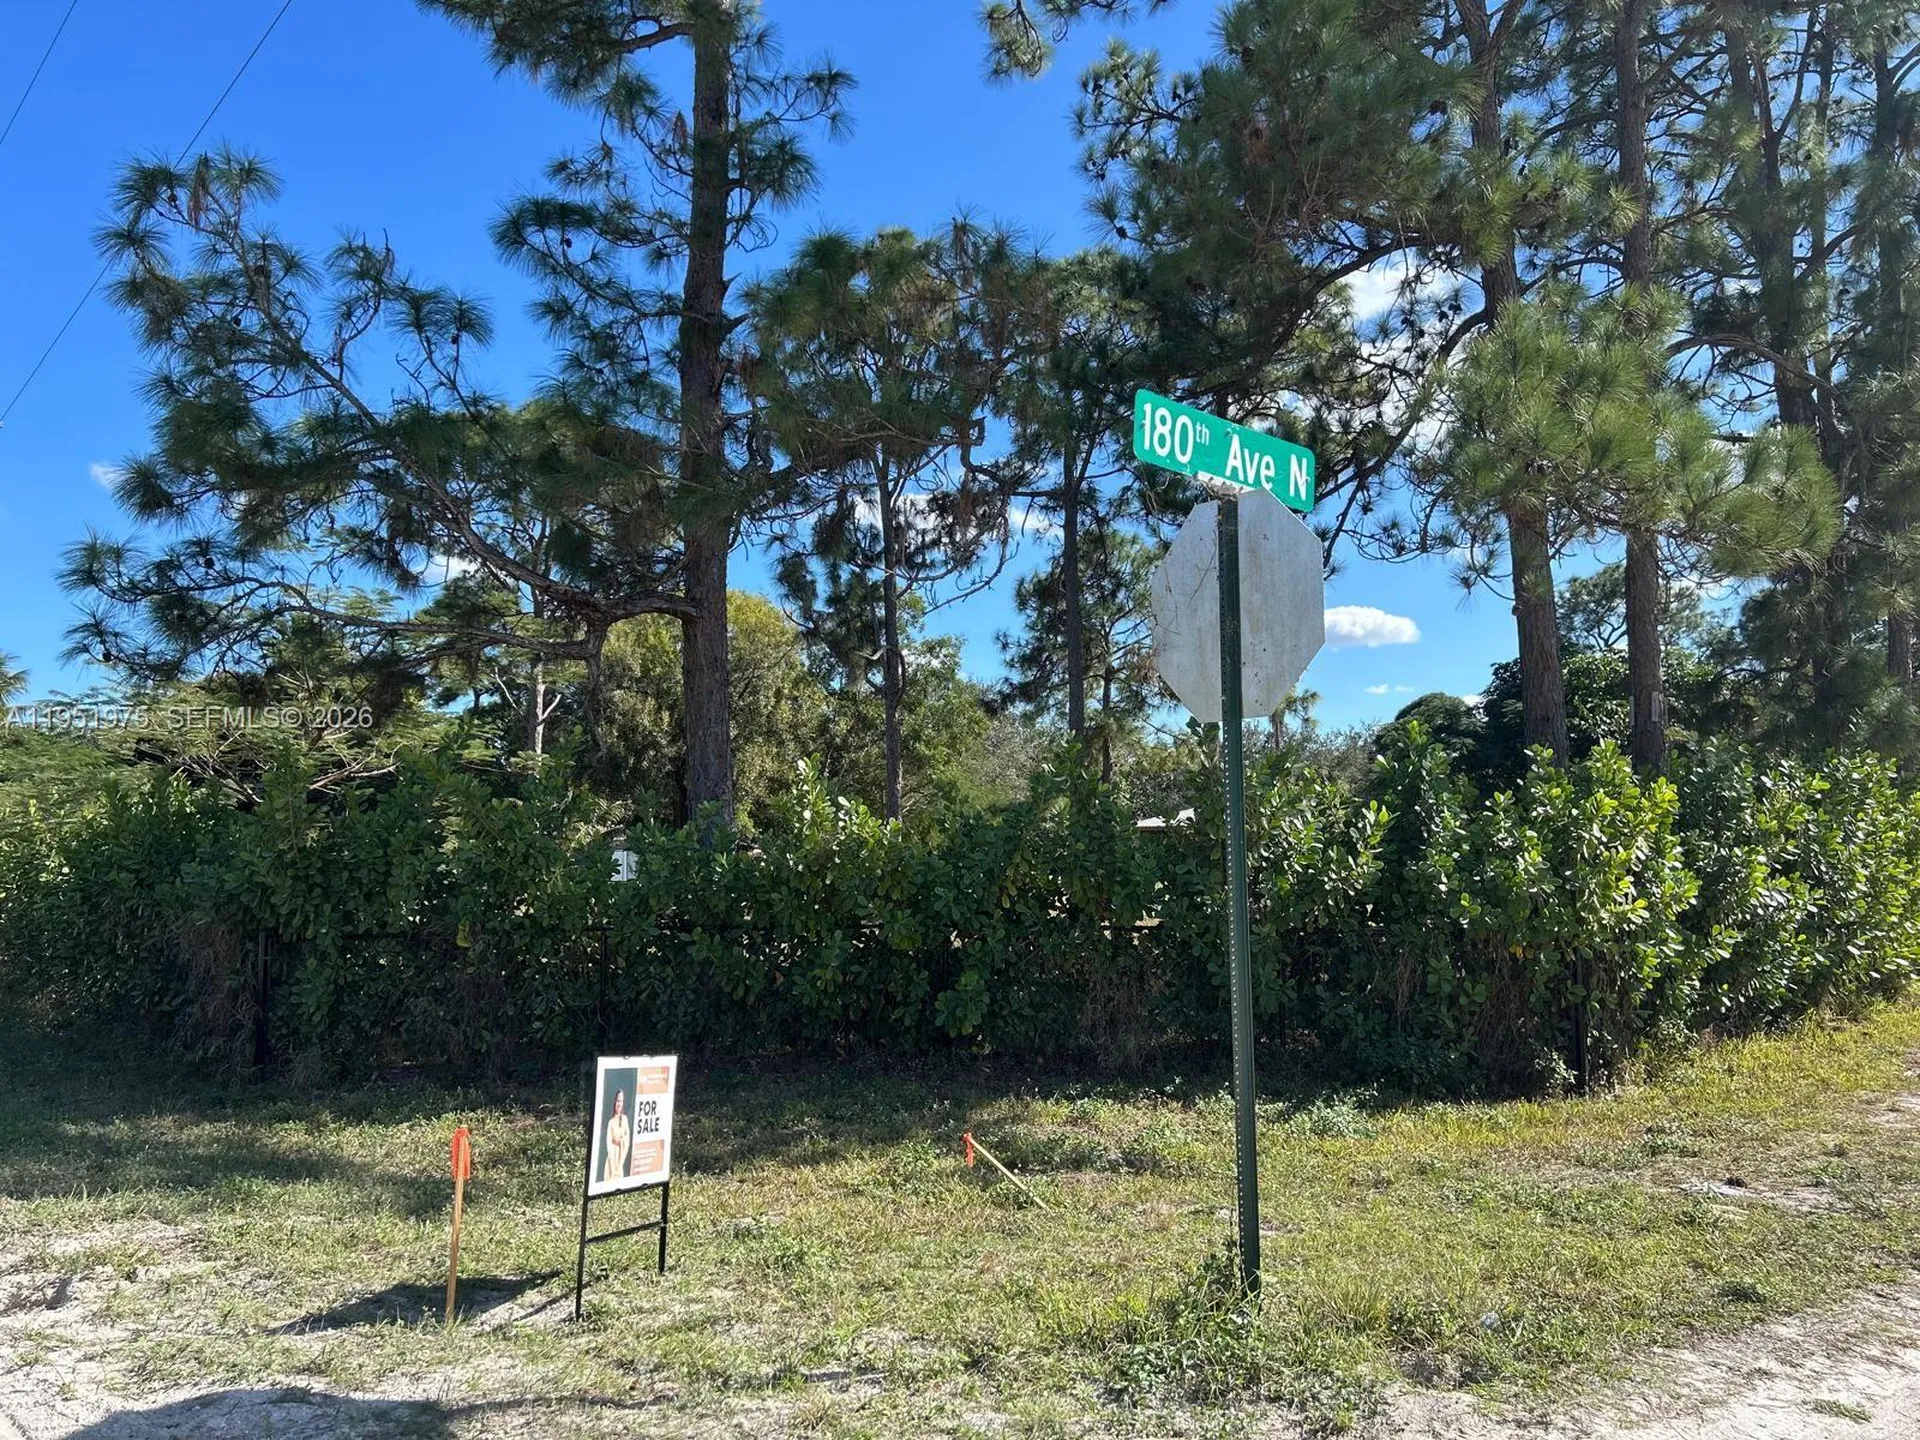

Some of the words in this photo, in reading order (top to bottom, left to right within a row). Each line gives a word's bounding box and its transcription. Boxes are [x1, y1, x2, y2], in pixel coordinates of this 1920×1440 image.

[1143, 402, 1209, 464] 180th
[1225, 434, 1275, 490] Ave
[1289, 453, 1308, 501] N
[638, 1100, 657, 1117] FOR
[637, 1117, 660, 1134] SALE
